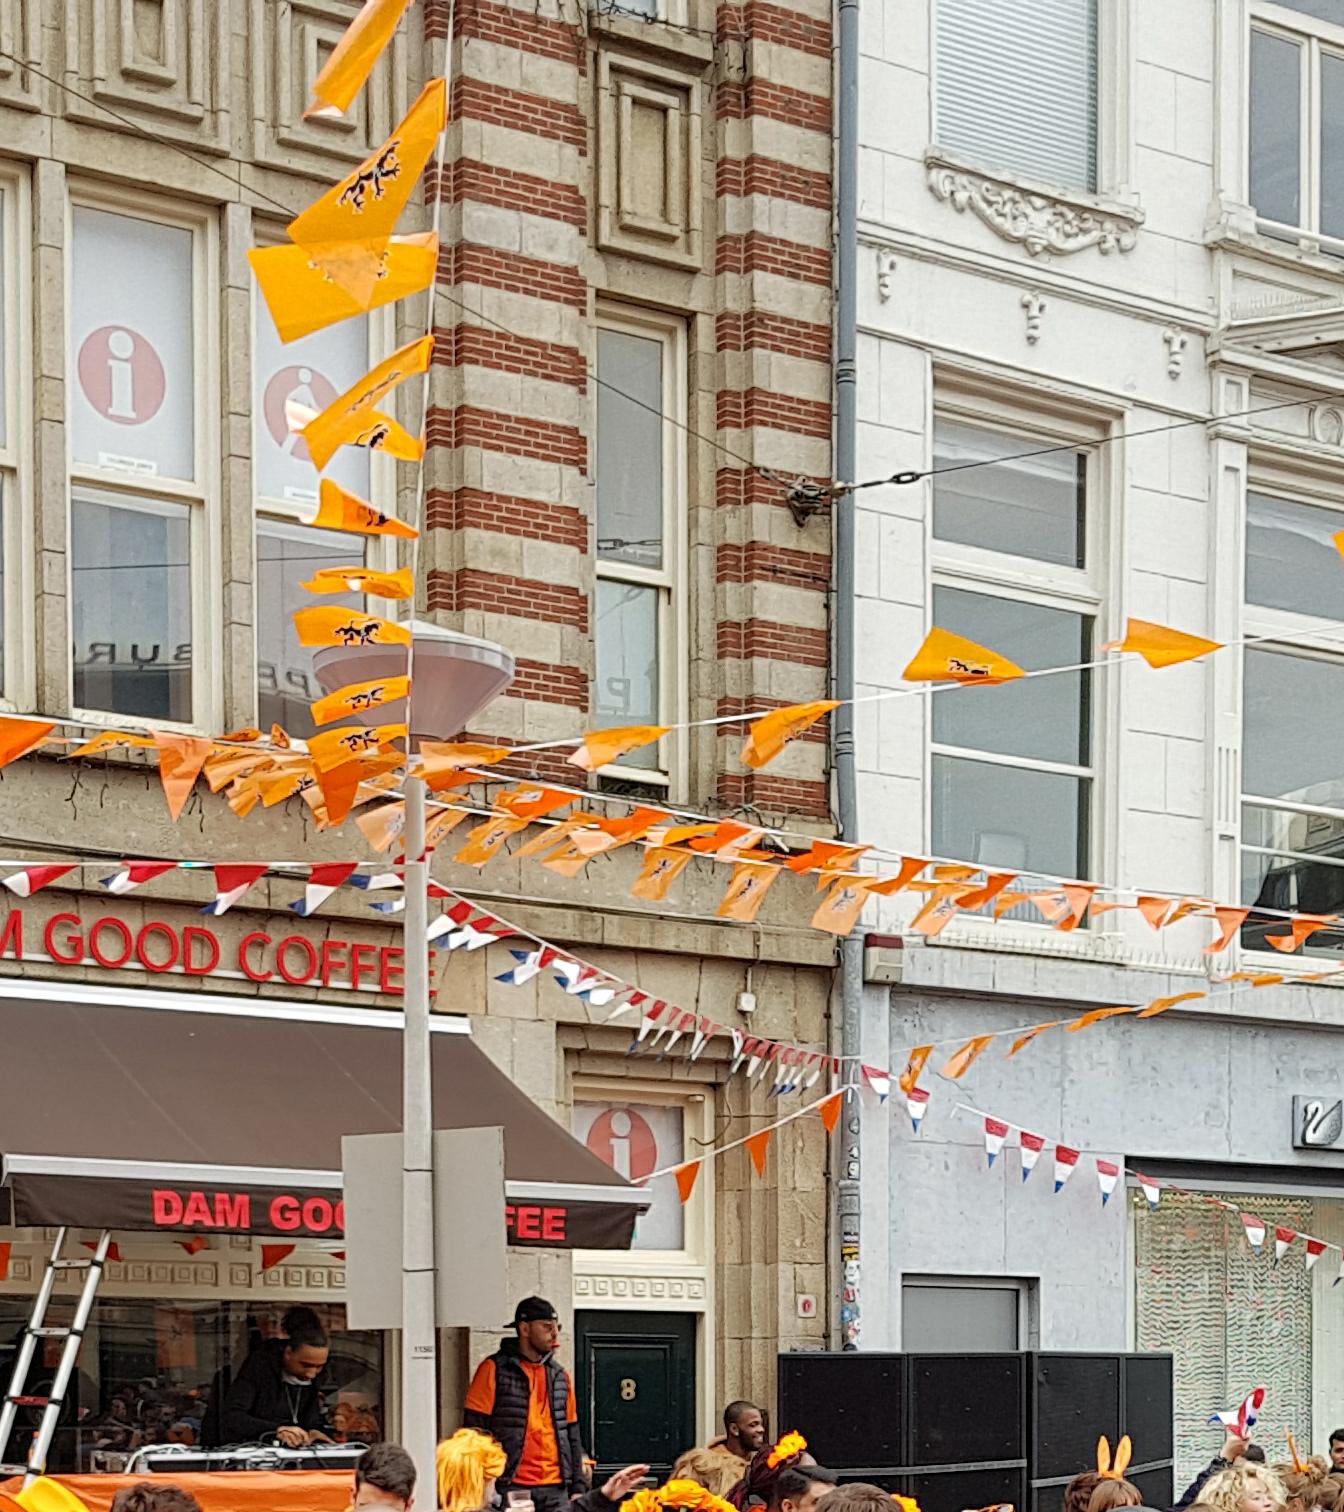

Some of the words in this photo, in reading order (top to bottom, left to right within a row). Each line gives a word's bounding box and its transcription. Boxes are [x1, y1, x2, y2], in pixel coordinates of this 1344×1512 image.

[44, 912, 220, 976] GOOD
[151, 1188, 252, 1230] DAM
[269, 1195, 345, 1233] GO
[620, 1378, 637, 1401] 8
